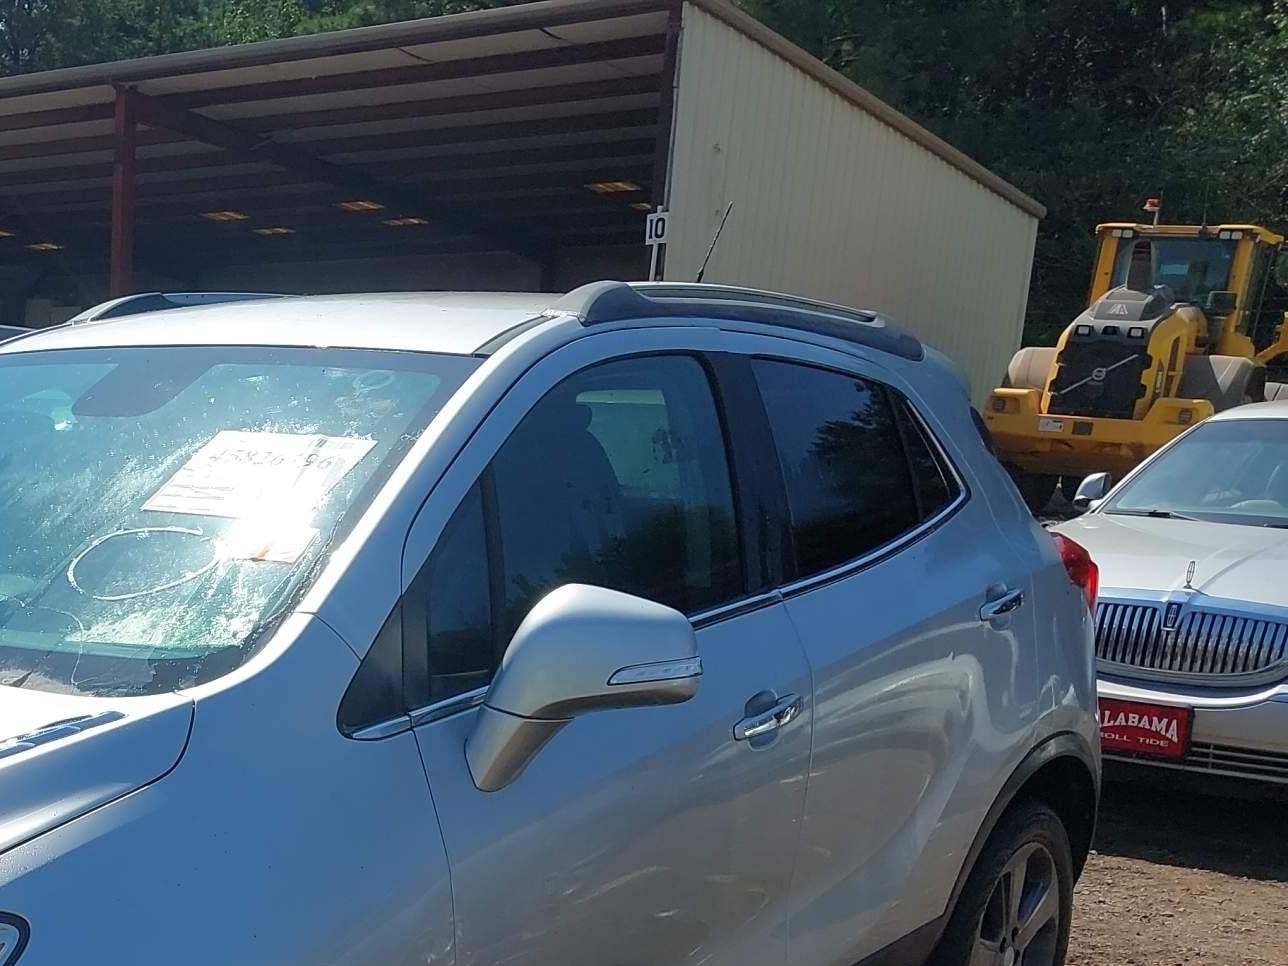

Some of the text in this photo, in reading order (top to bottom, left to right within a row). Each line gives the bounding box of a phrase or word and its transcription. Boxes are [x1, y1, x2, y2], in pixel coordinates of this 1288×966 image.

[648, 217, 665, 239] 10
[208, 449, 337, 470] 4582696
[1137, 736, 1169, 747] TIDE
